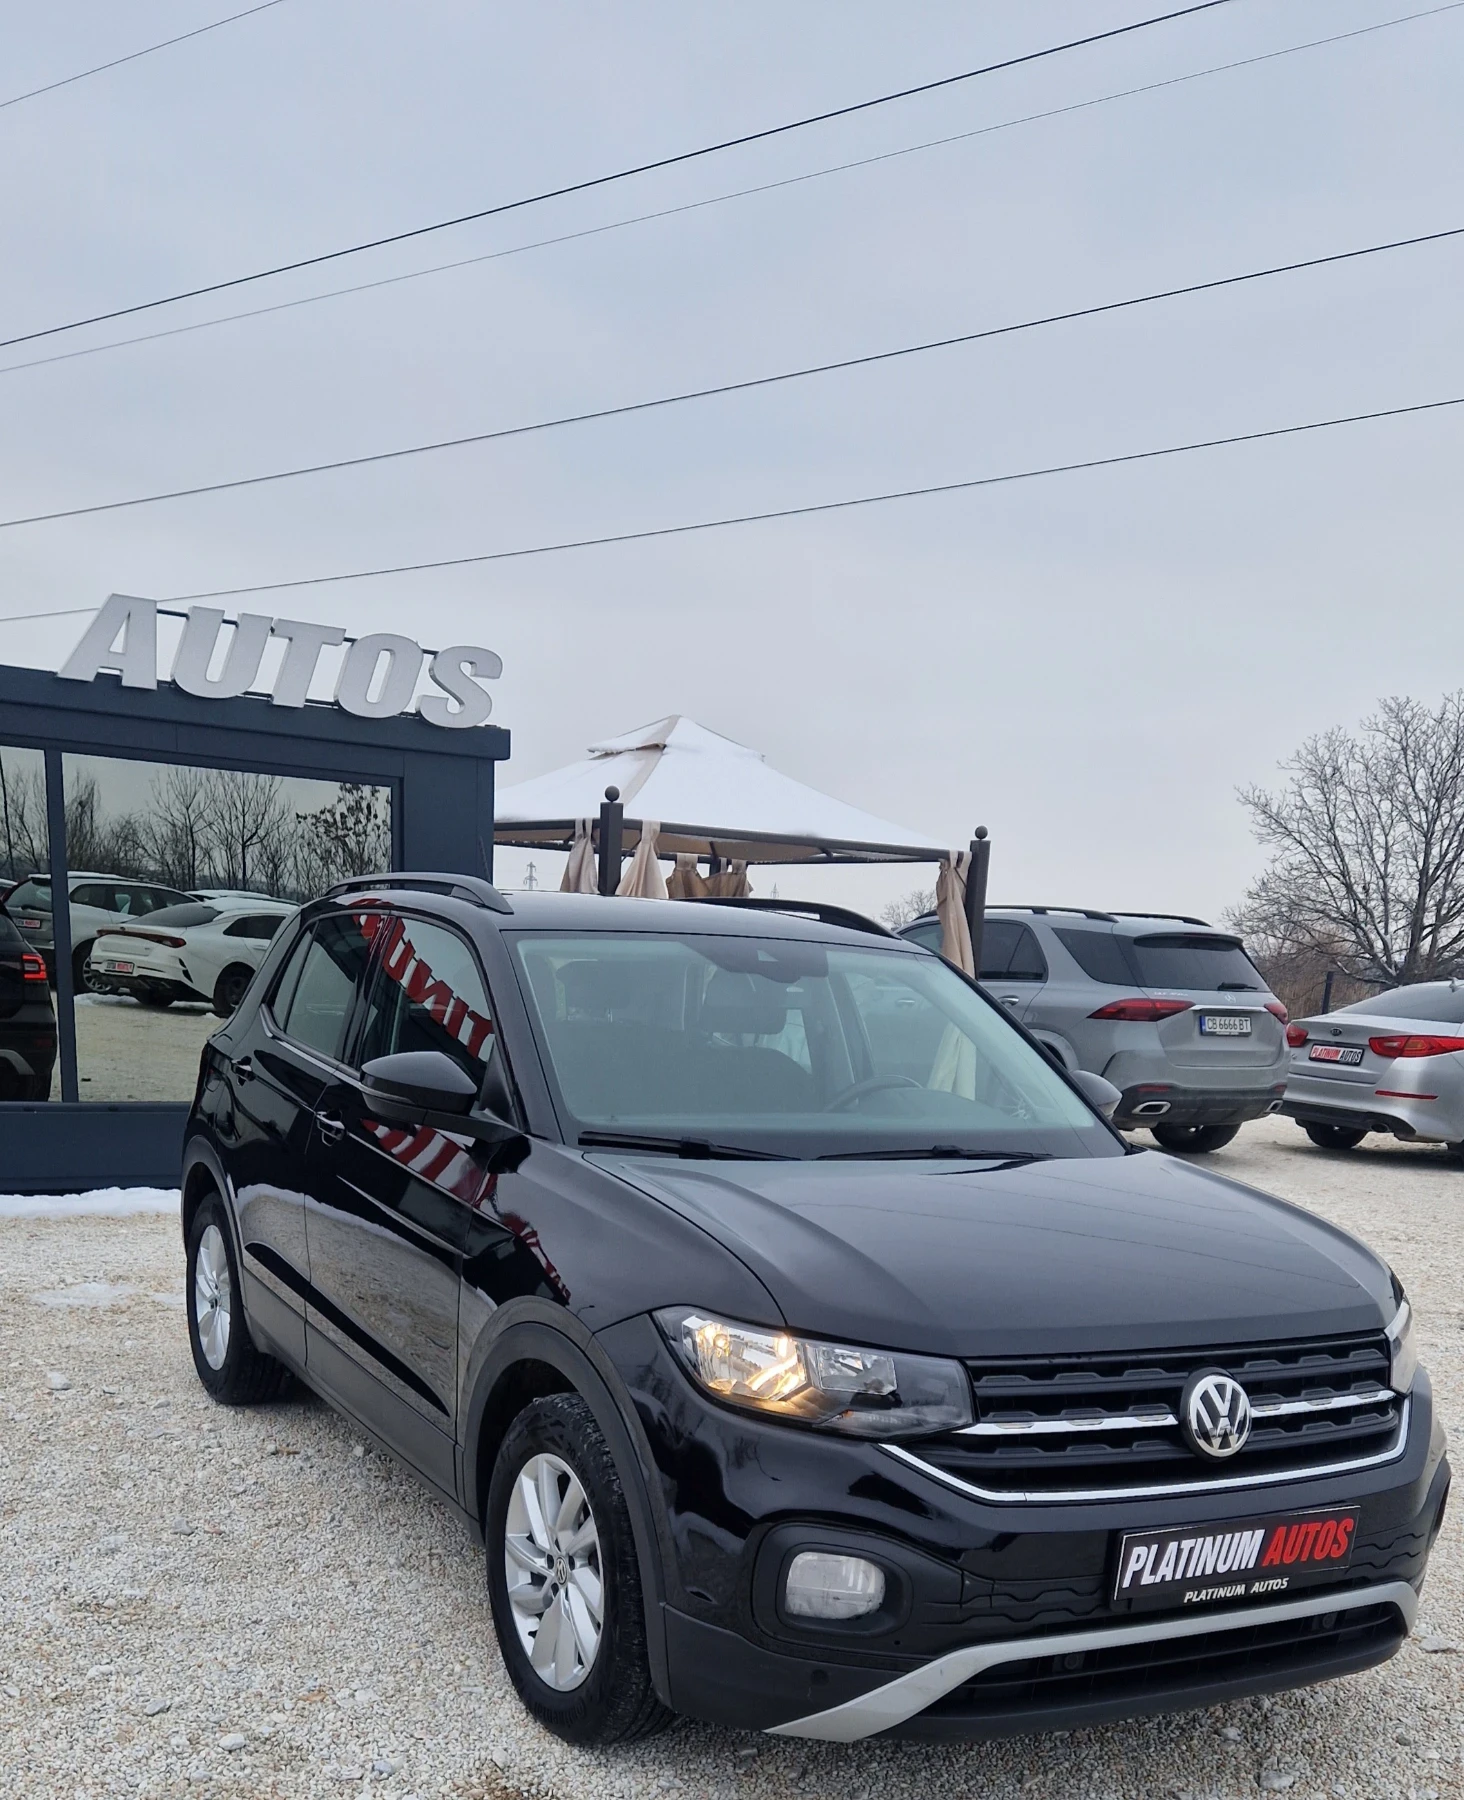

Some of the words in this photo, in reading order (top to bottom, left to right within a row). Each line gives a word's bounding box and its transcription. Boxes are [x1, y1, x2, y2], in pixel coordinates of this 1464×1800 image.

[57, 593, 503, 728] AUTOS
[1207, 1018, 1217, 1030] CB
[1218, 1018, 1238, 1030] 6666
[1239, 1018, 1249, 1031] BT
[1339, 1049, 1362, 1062] AUTOS
[1122, 1529, 1265, 1589] PLATINUM
[1262, 1518, 1354, 1567] AUTOS
[1184, 1584, 1245, 1603] PLATINUM
[1251, 1577, 1289, 1593] AUTOS
